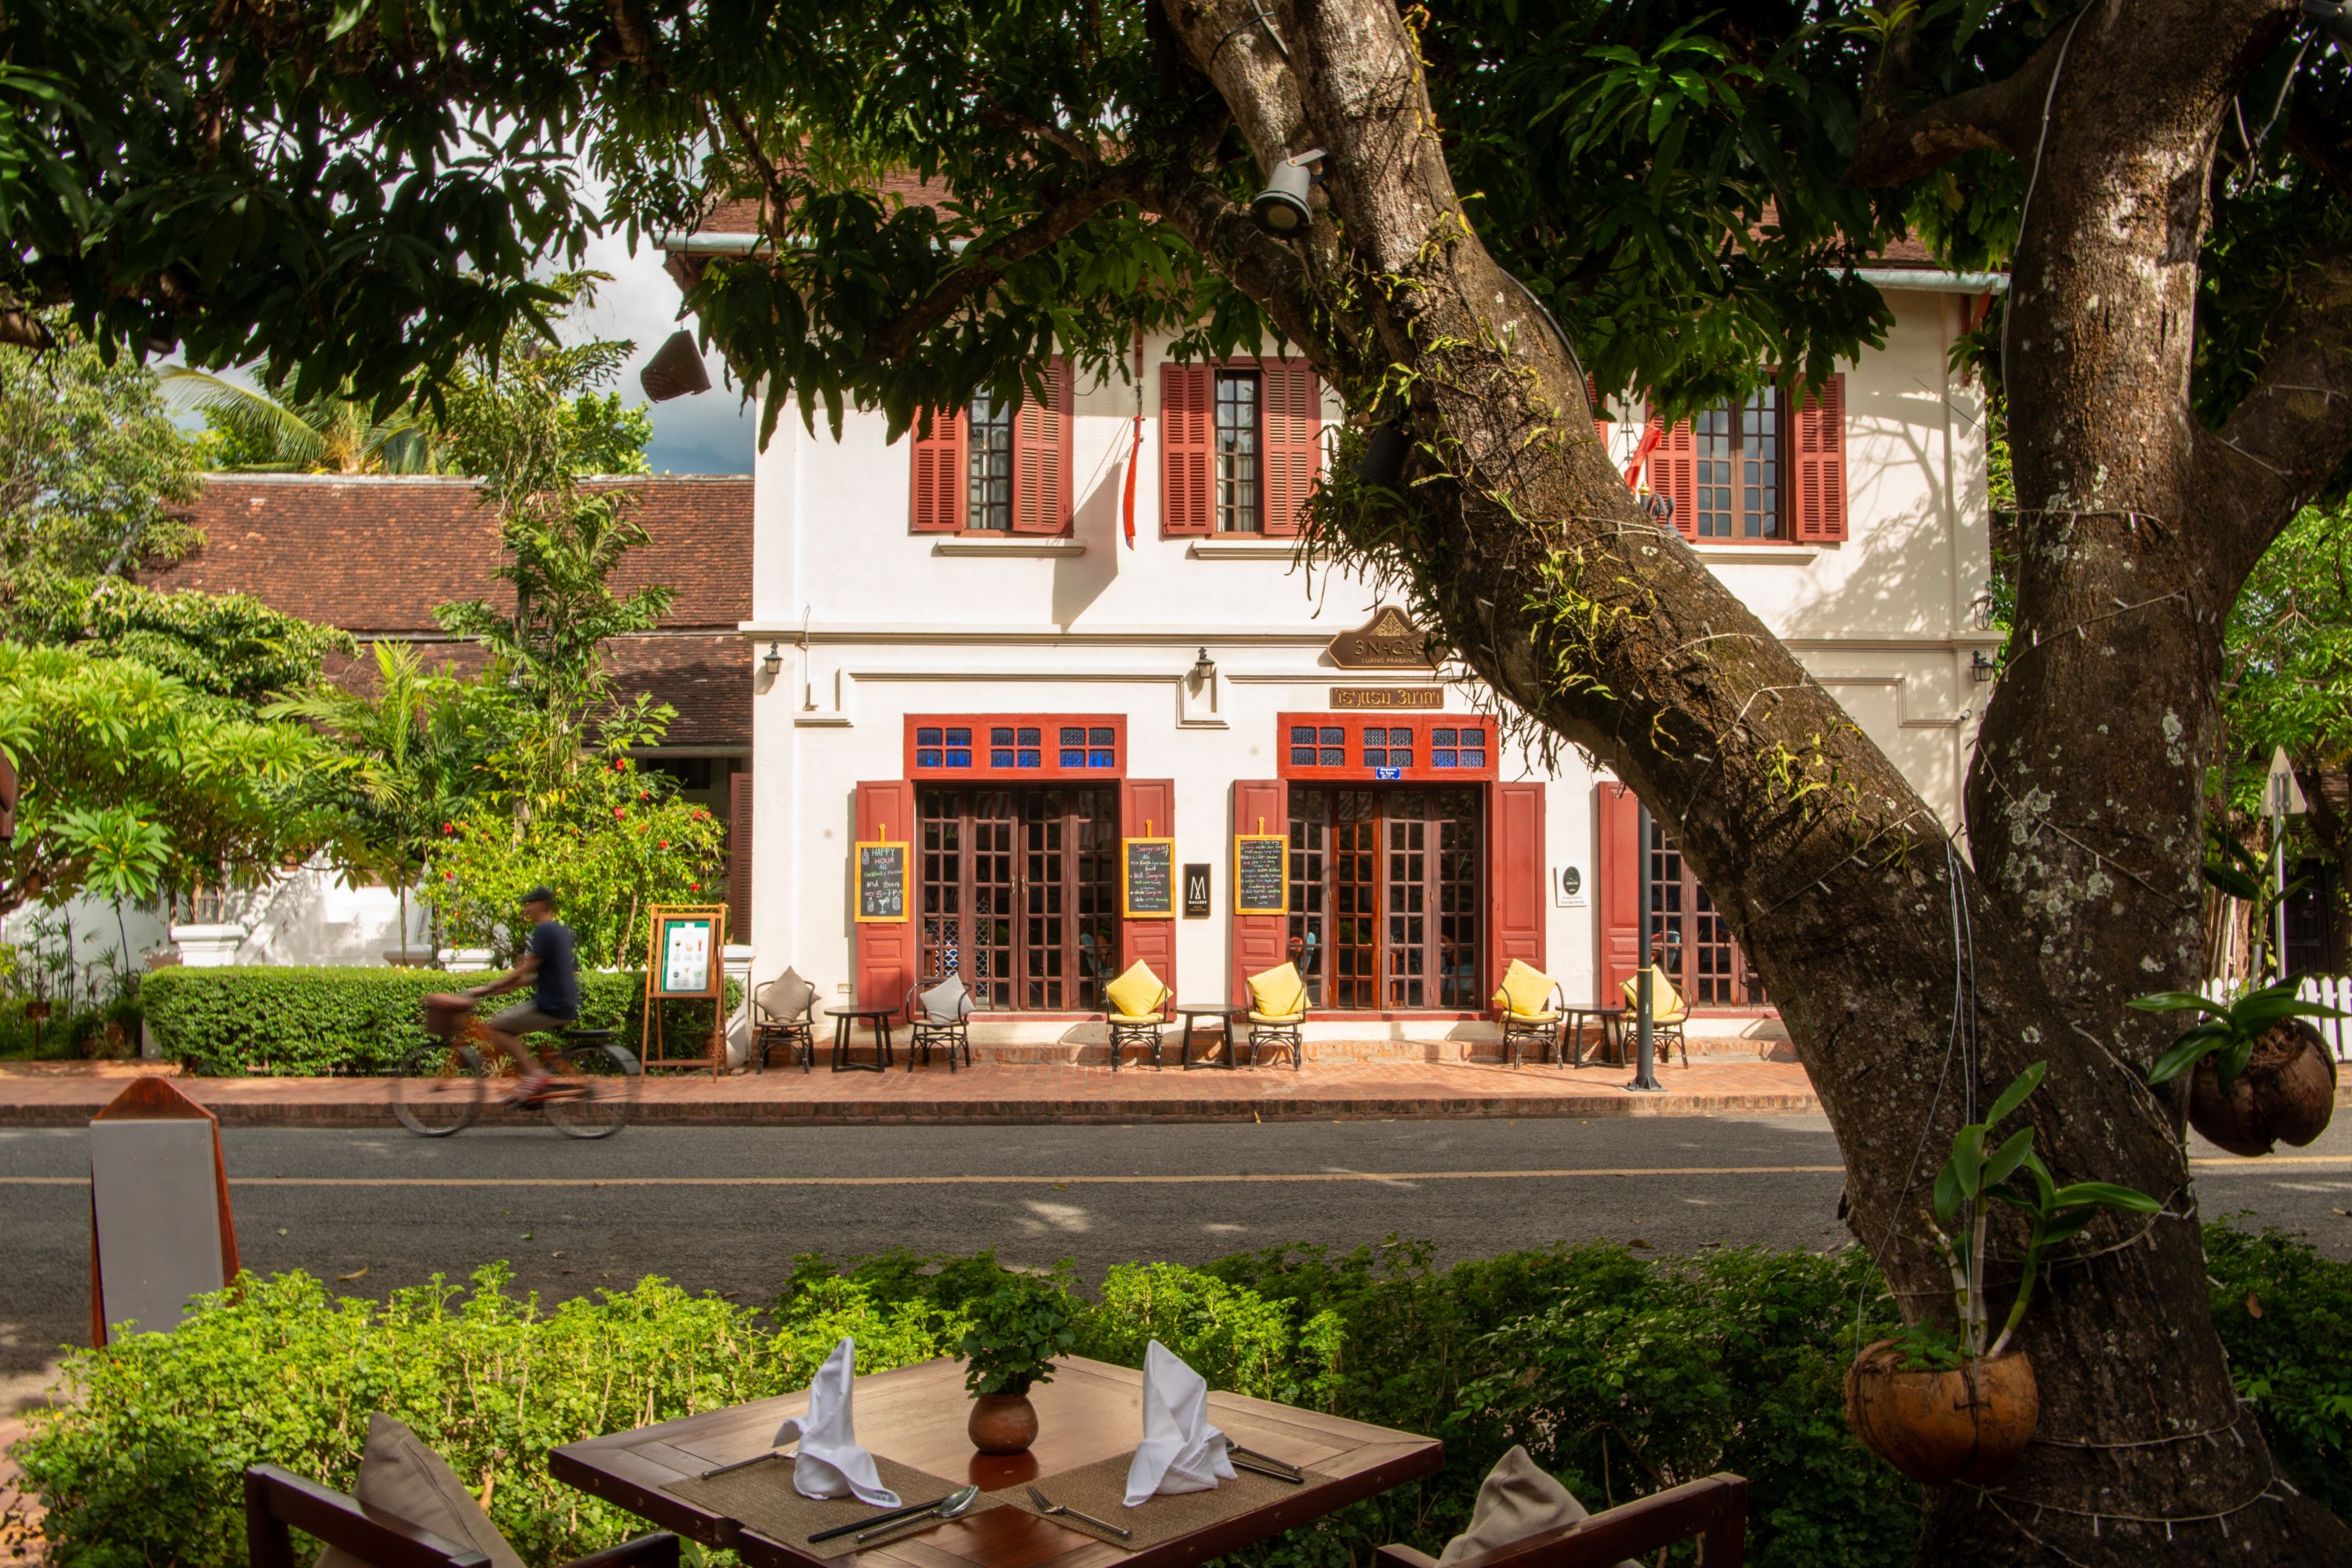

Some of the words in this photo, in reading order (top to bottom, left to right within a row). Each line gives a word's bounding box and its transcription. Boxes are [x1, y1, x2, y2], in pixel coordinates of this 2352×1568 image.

[1355, 640, 1364, 655] 3
[1367, 640, 1425, 655] NAGAS
[872, 848, 895, 856] HAPPY
